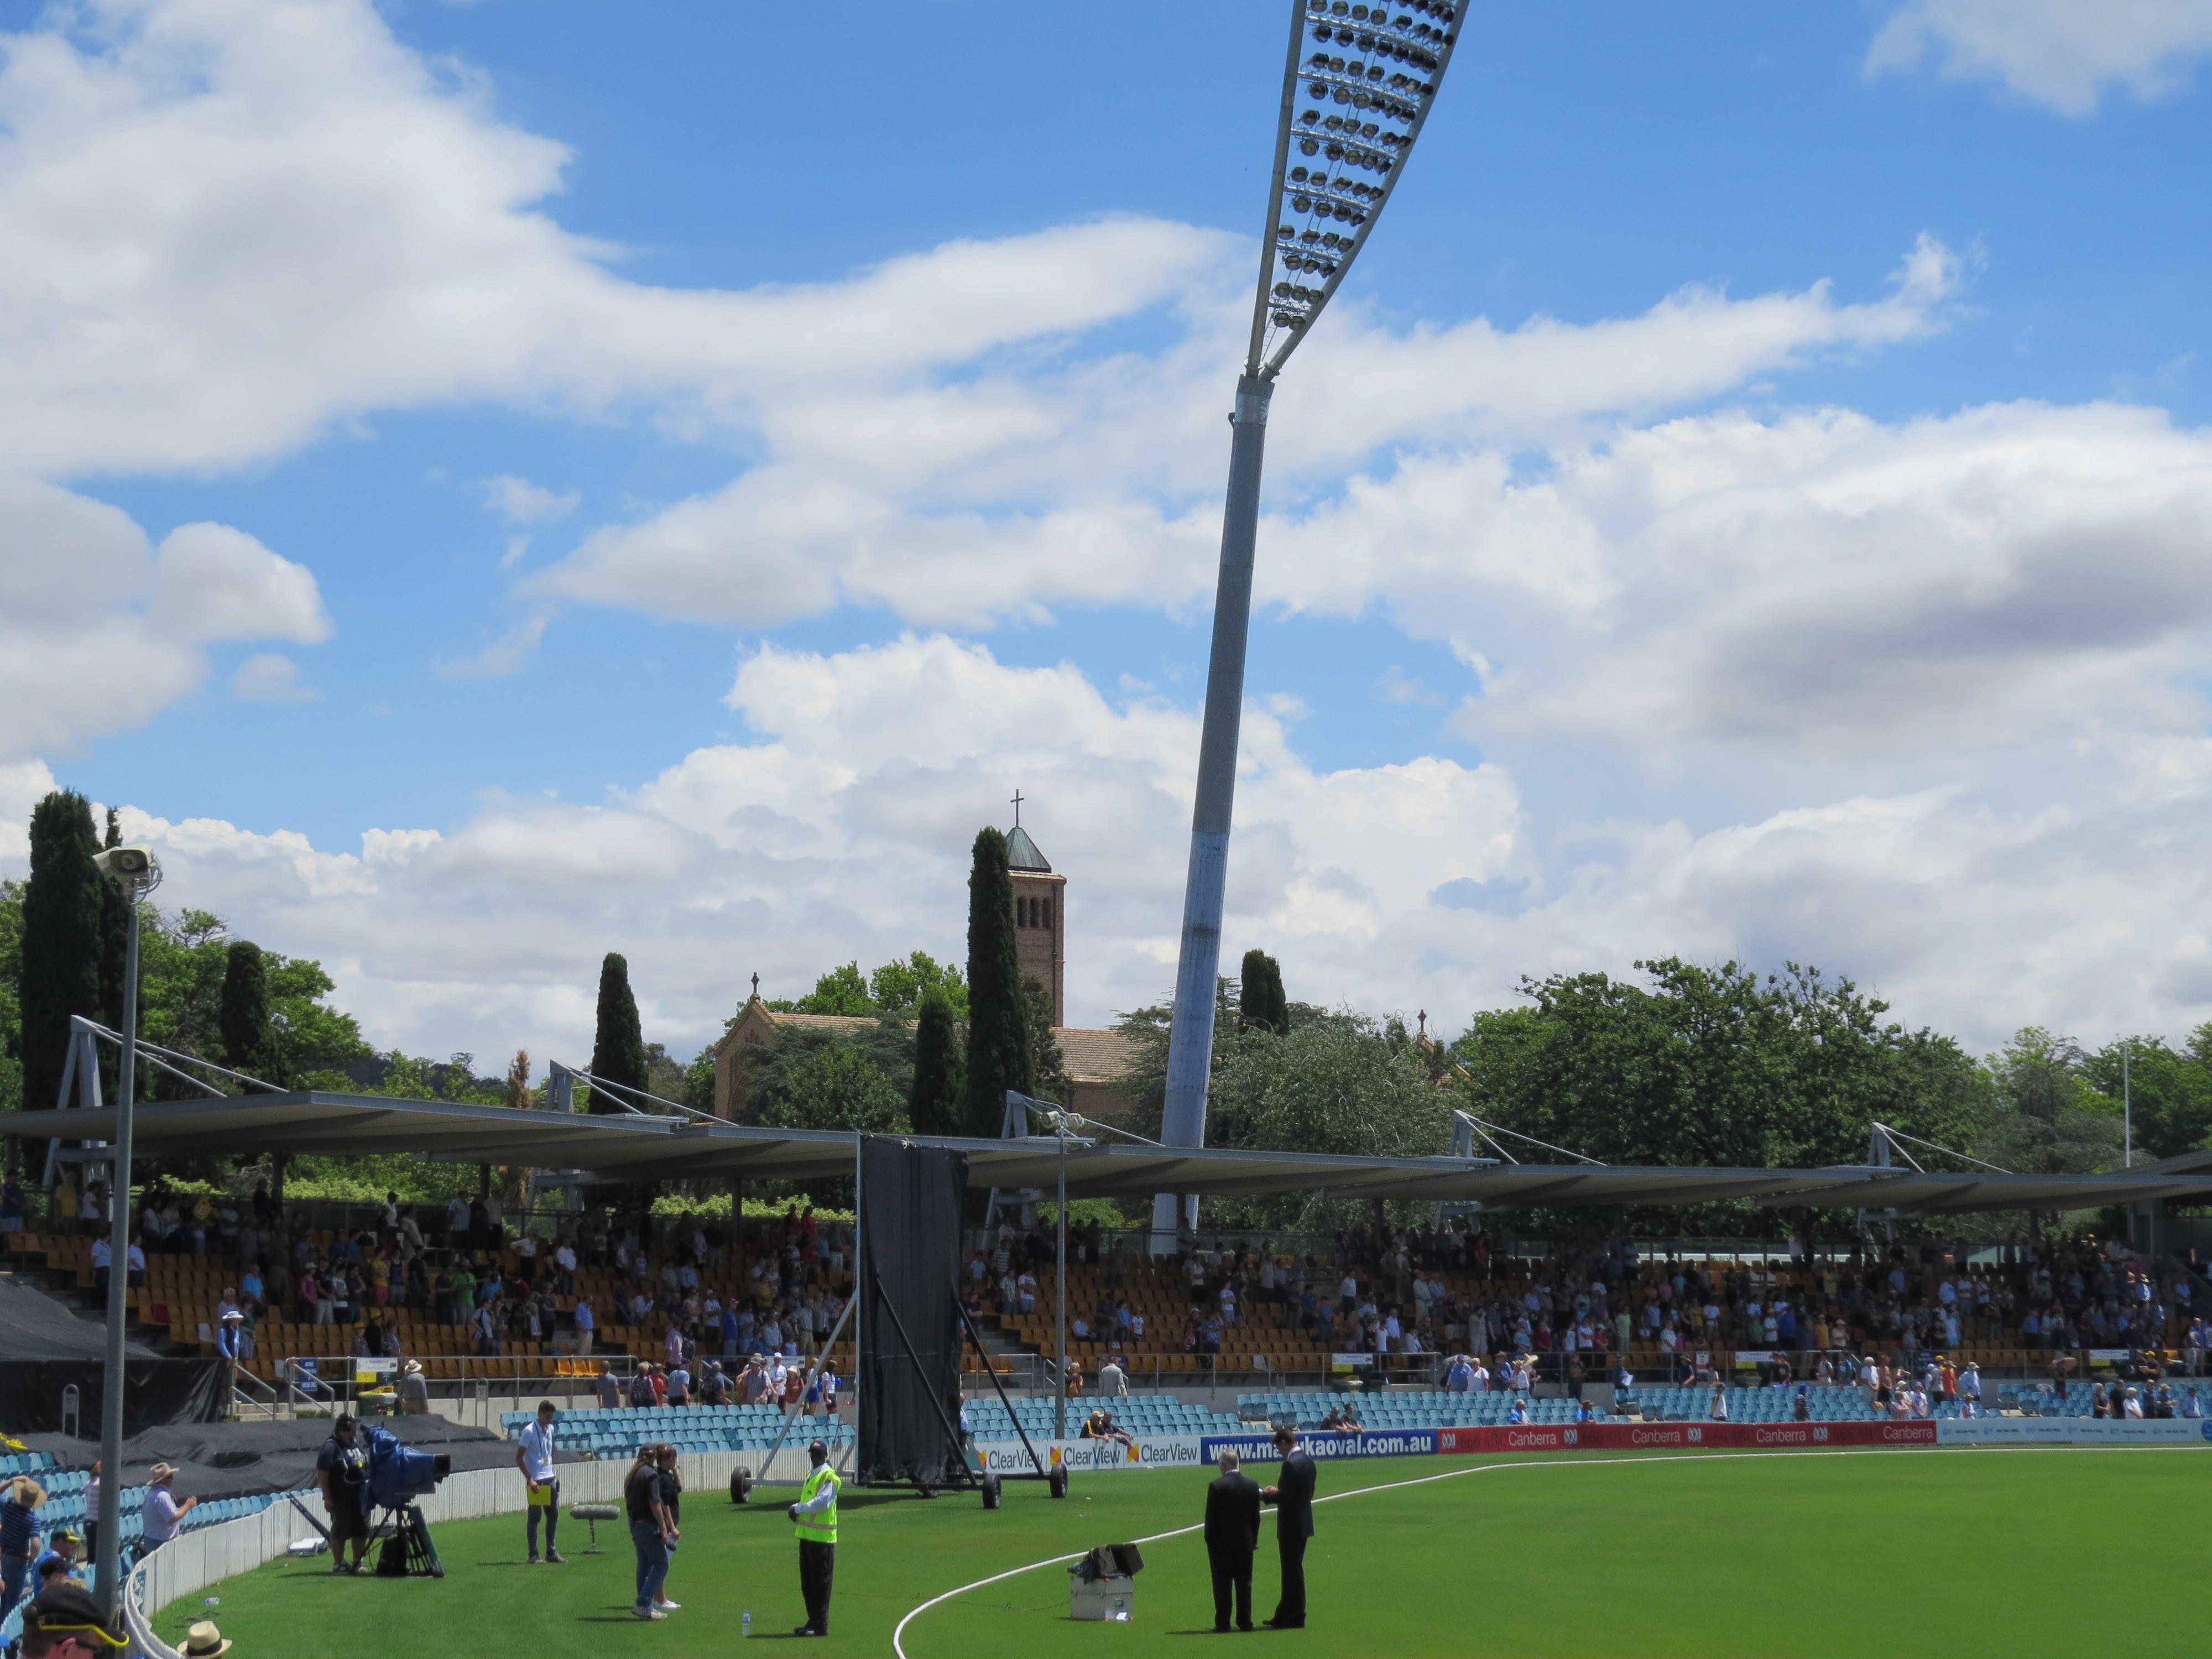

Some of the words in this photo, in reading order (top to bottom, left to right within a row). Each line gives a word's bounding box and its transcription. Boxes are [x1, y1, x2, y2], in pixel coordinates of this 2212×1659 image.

[1509, 1431, 1557, 1446] Canberra
[1632, 1429, 1681, 1443] Canberra
[1756, 1428, 1806, 1443] Canberra
[1883, 1426, 1933, 1439] Canberra
[1141, 1443, 1197, 1463] ClearView
[1208, 1434, 1432, 1460] ww.makaoval.com.au
[1063, 1446, 1120, 1465] ClearView
